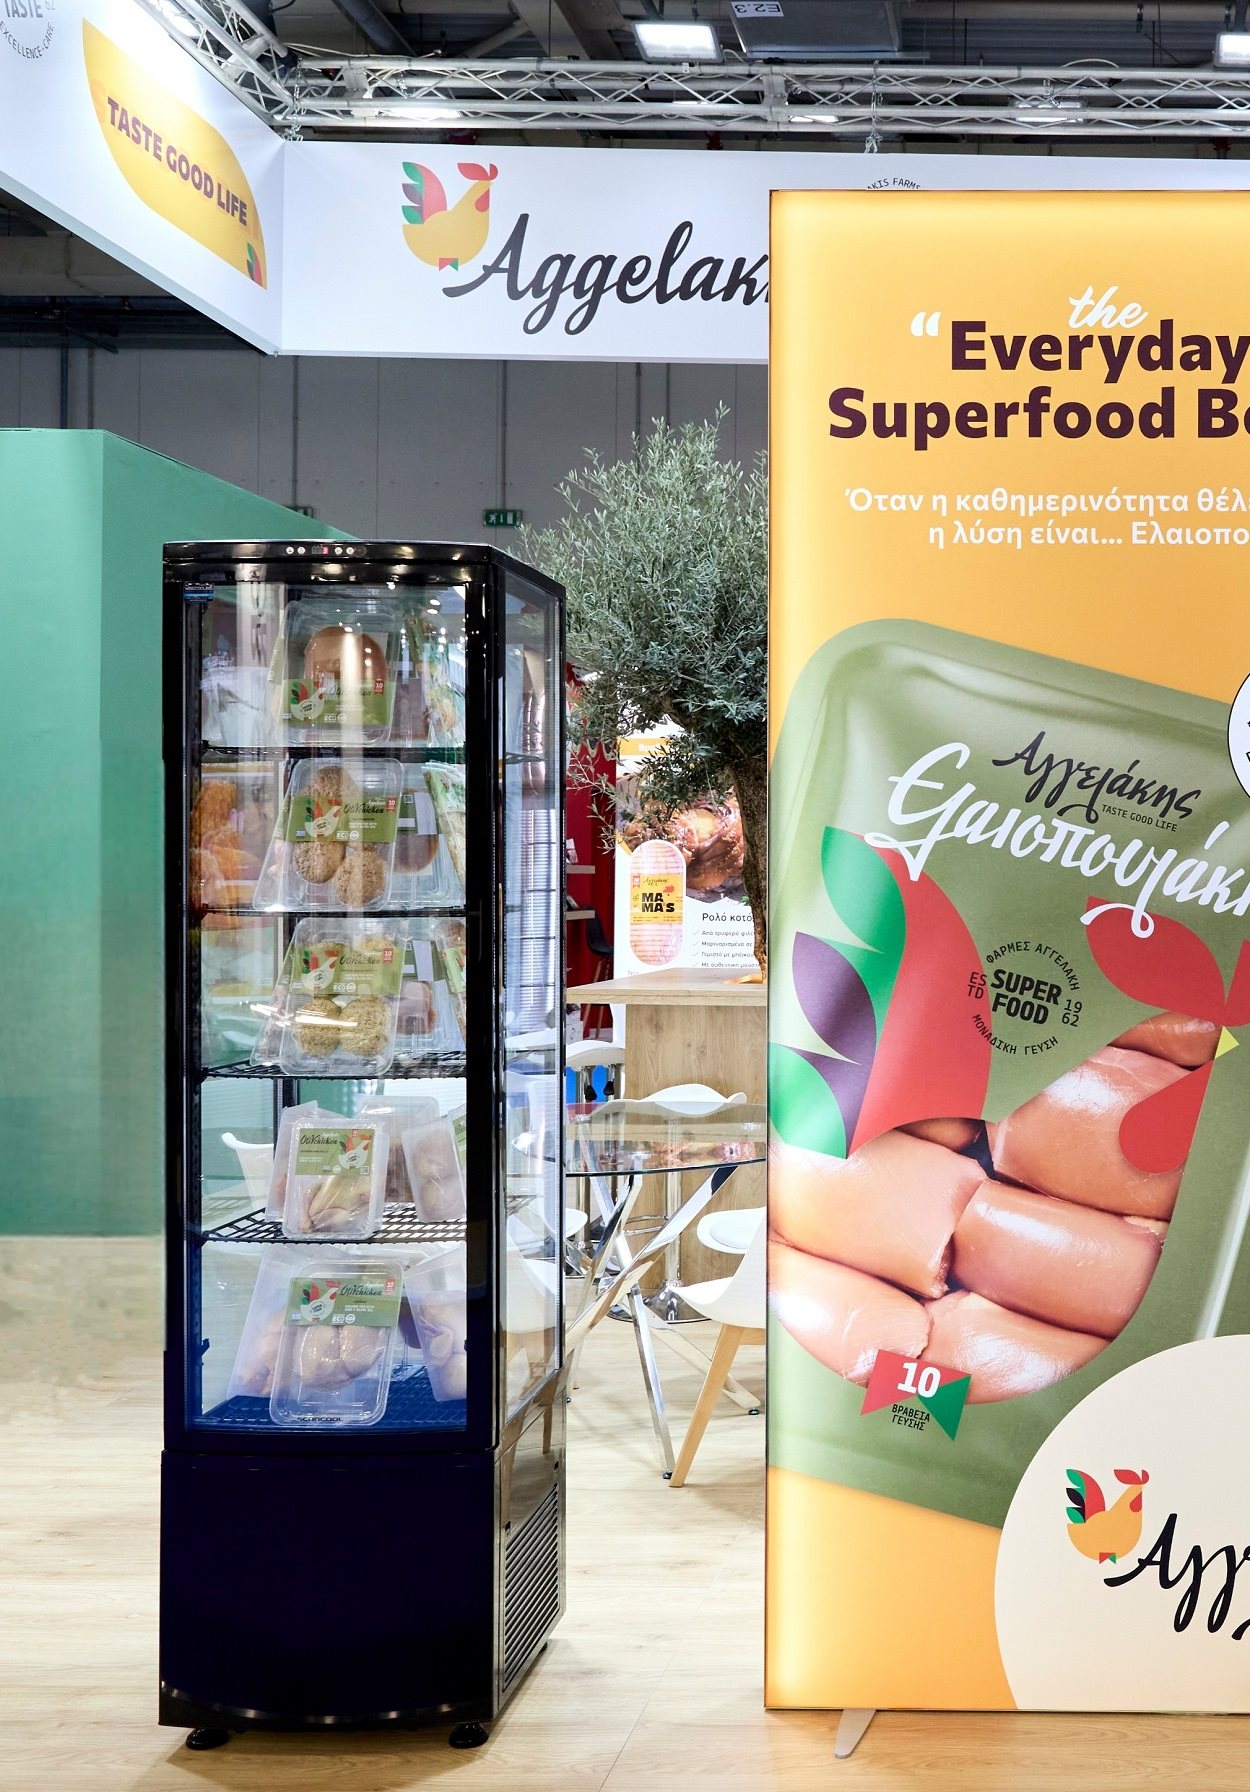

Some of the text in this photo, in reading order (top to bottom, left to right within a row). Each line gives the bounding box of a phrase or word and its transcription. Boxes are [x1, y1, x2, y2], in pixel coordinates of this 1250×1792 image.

[107, 96, 247, 226] TASTE GOOD LIFE
[442, 213, 769, 335] Aggelak
[1069, 286, 1148, 329] the
[828, 386, 1175, 451] Superfood
[844, 487, 924, 512] Όταν
[931, 494, 948, 517] η
[956, 487, 1189, 518] καθημερινότητα
[929, 527, 945, 550] η
[952, 520, 1022, 550] λύση
[1030, 520, 1122, 546] είναι...
[992, 731, 1202, 824] Αγγελάκης
[1101, 803, 1178, 832] TASTE GOOD LIFE
[641, 892, 664, 902] MA
[702, 911, 753, 921] Ρολό κοτό
[970, 971, 987, 987] ES
[986, 941, 1080, 991] ΦΑΡΜΕΣ ΑΓΓΕΛΑΚΗ
[968, 985, 984, 999] TD
[990, 969, 1062, 1005] SUPER
[992, 992, 1049, 1025] FOOD
[1062, 1012, 1079, 1027] 62
[1064, 999, 1082, 1013] 19
[972, 1014, 1058, 1055] ΜΟΝΑΔΙΚΗ ΓΕΥΣΗ
[897, 1362, 941, 1399] 10
[891, 1404, 930, 1422] ΒΡΑΒΕΙΑ
[892, 1415, 926, 1431] ΓΕΥΣΗΣ
